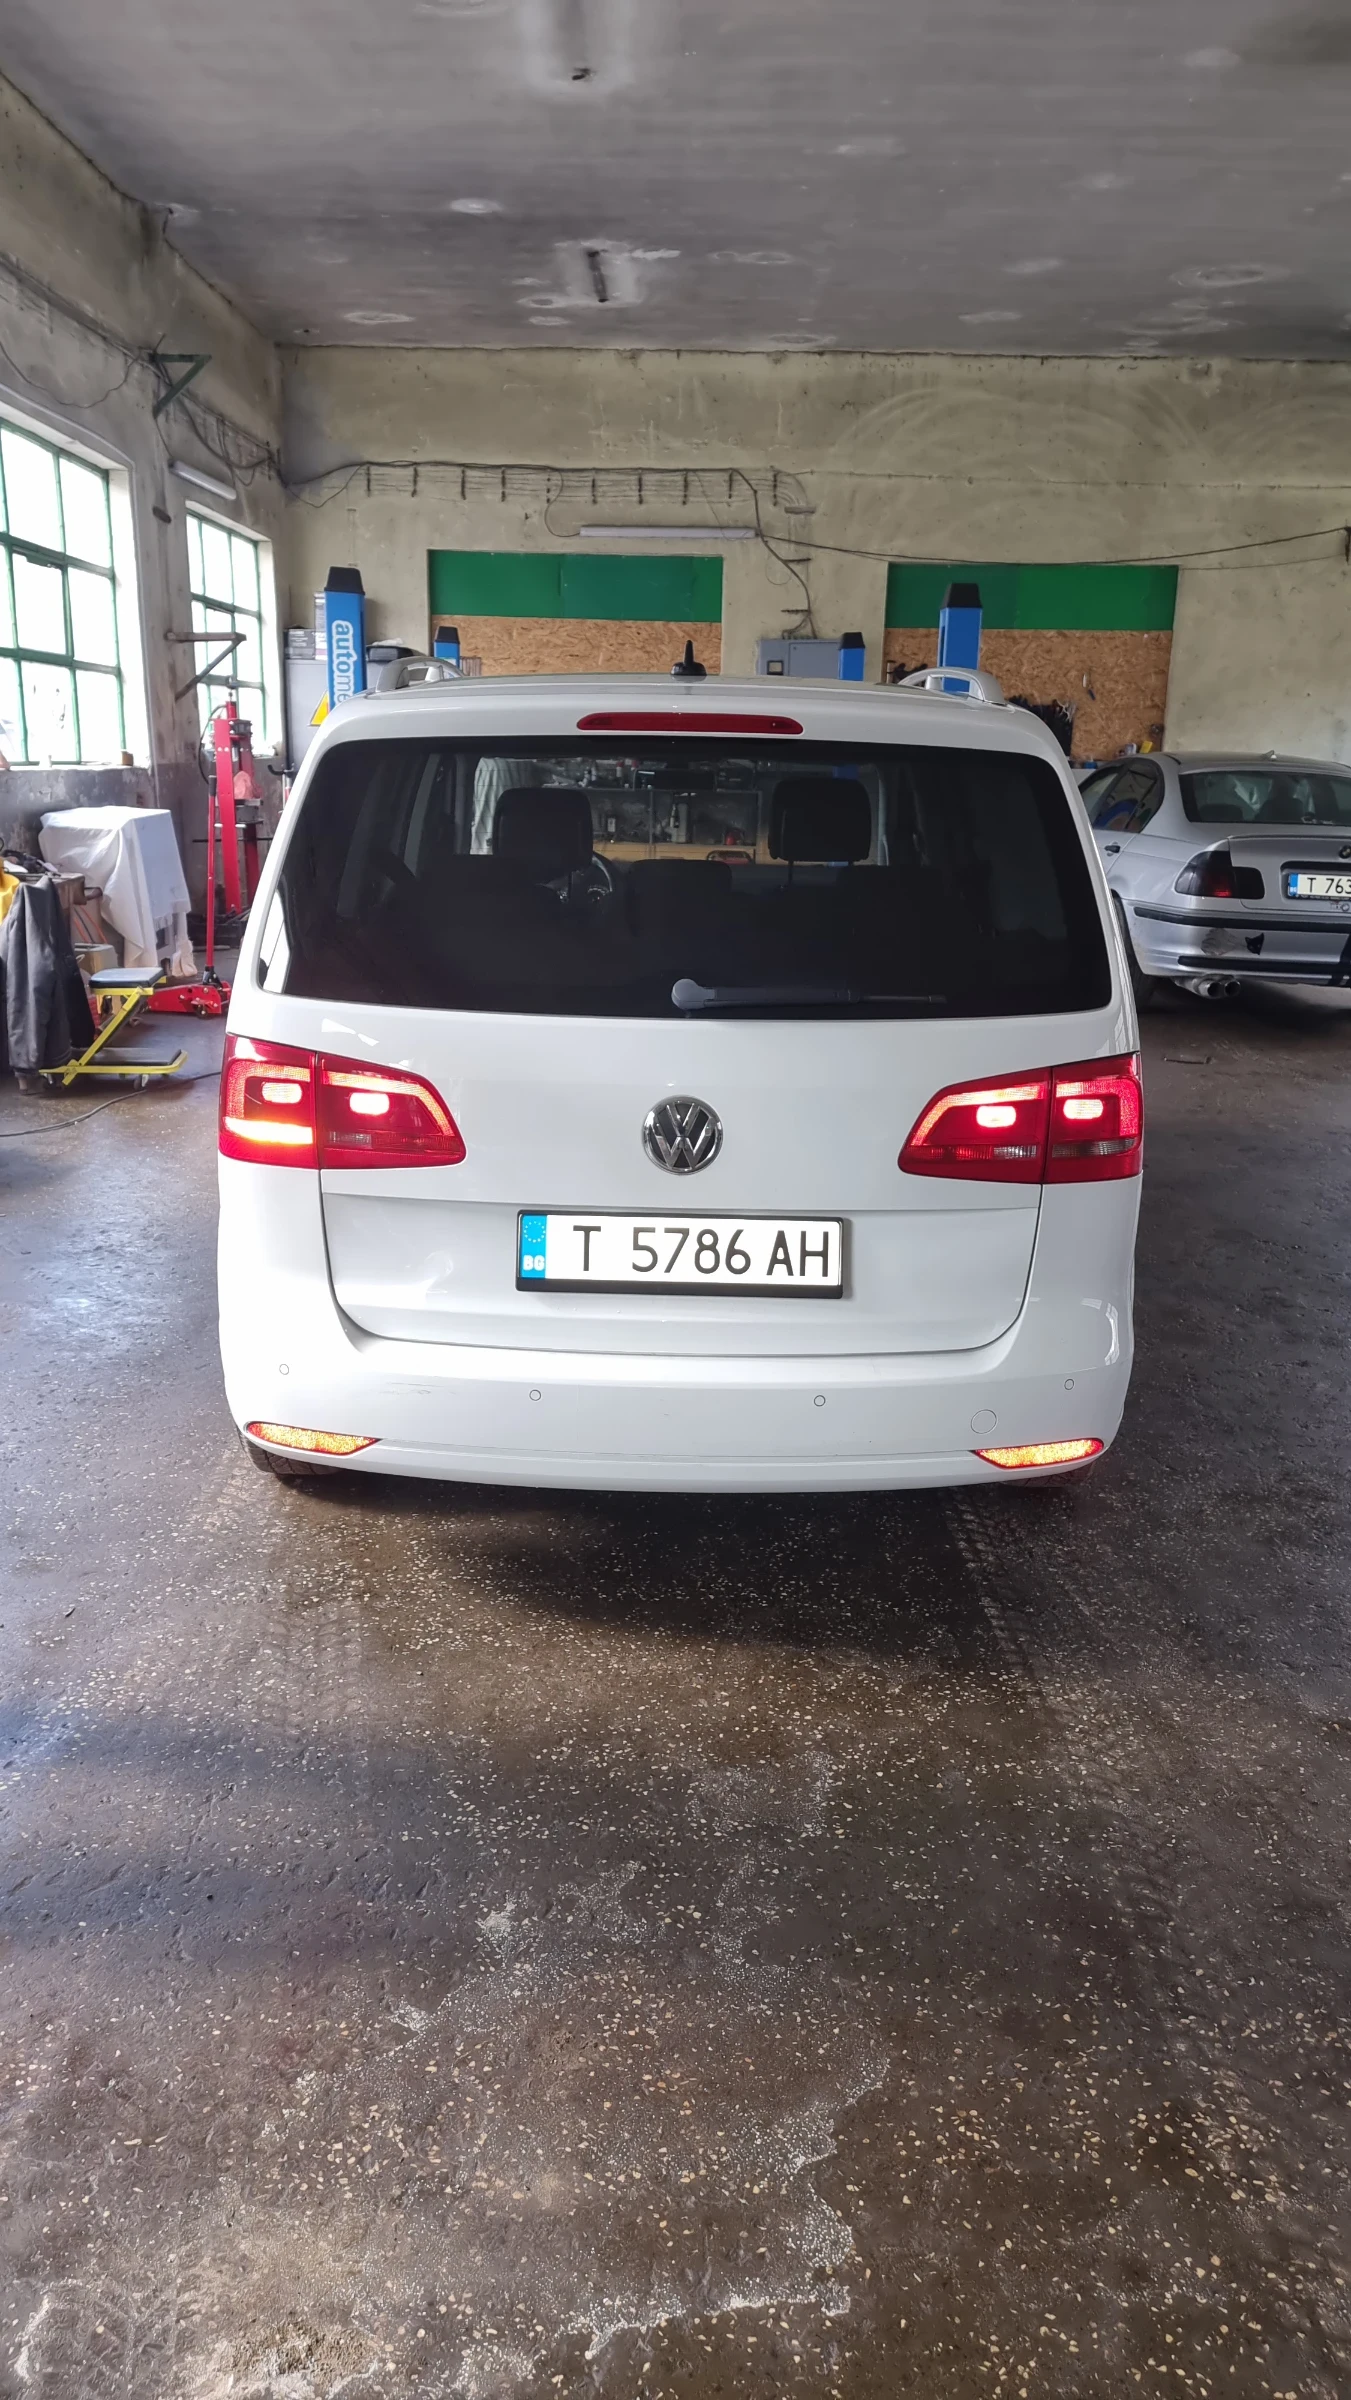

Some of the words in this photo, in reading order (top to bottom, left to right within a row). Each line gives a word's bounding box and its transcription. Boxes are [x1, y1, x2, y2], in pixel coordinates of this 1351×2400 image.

[1307, 877, 1317, 893] T
[573, 1225, 602, 1271] T
[632, 1227, 751, 1275] 5786
[766, 1230, 829, 1277] AH
[523, 1254, 545, 1271] BG
